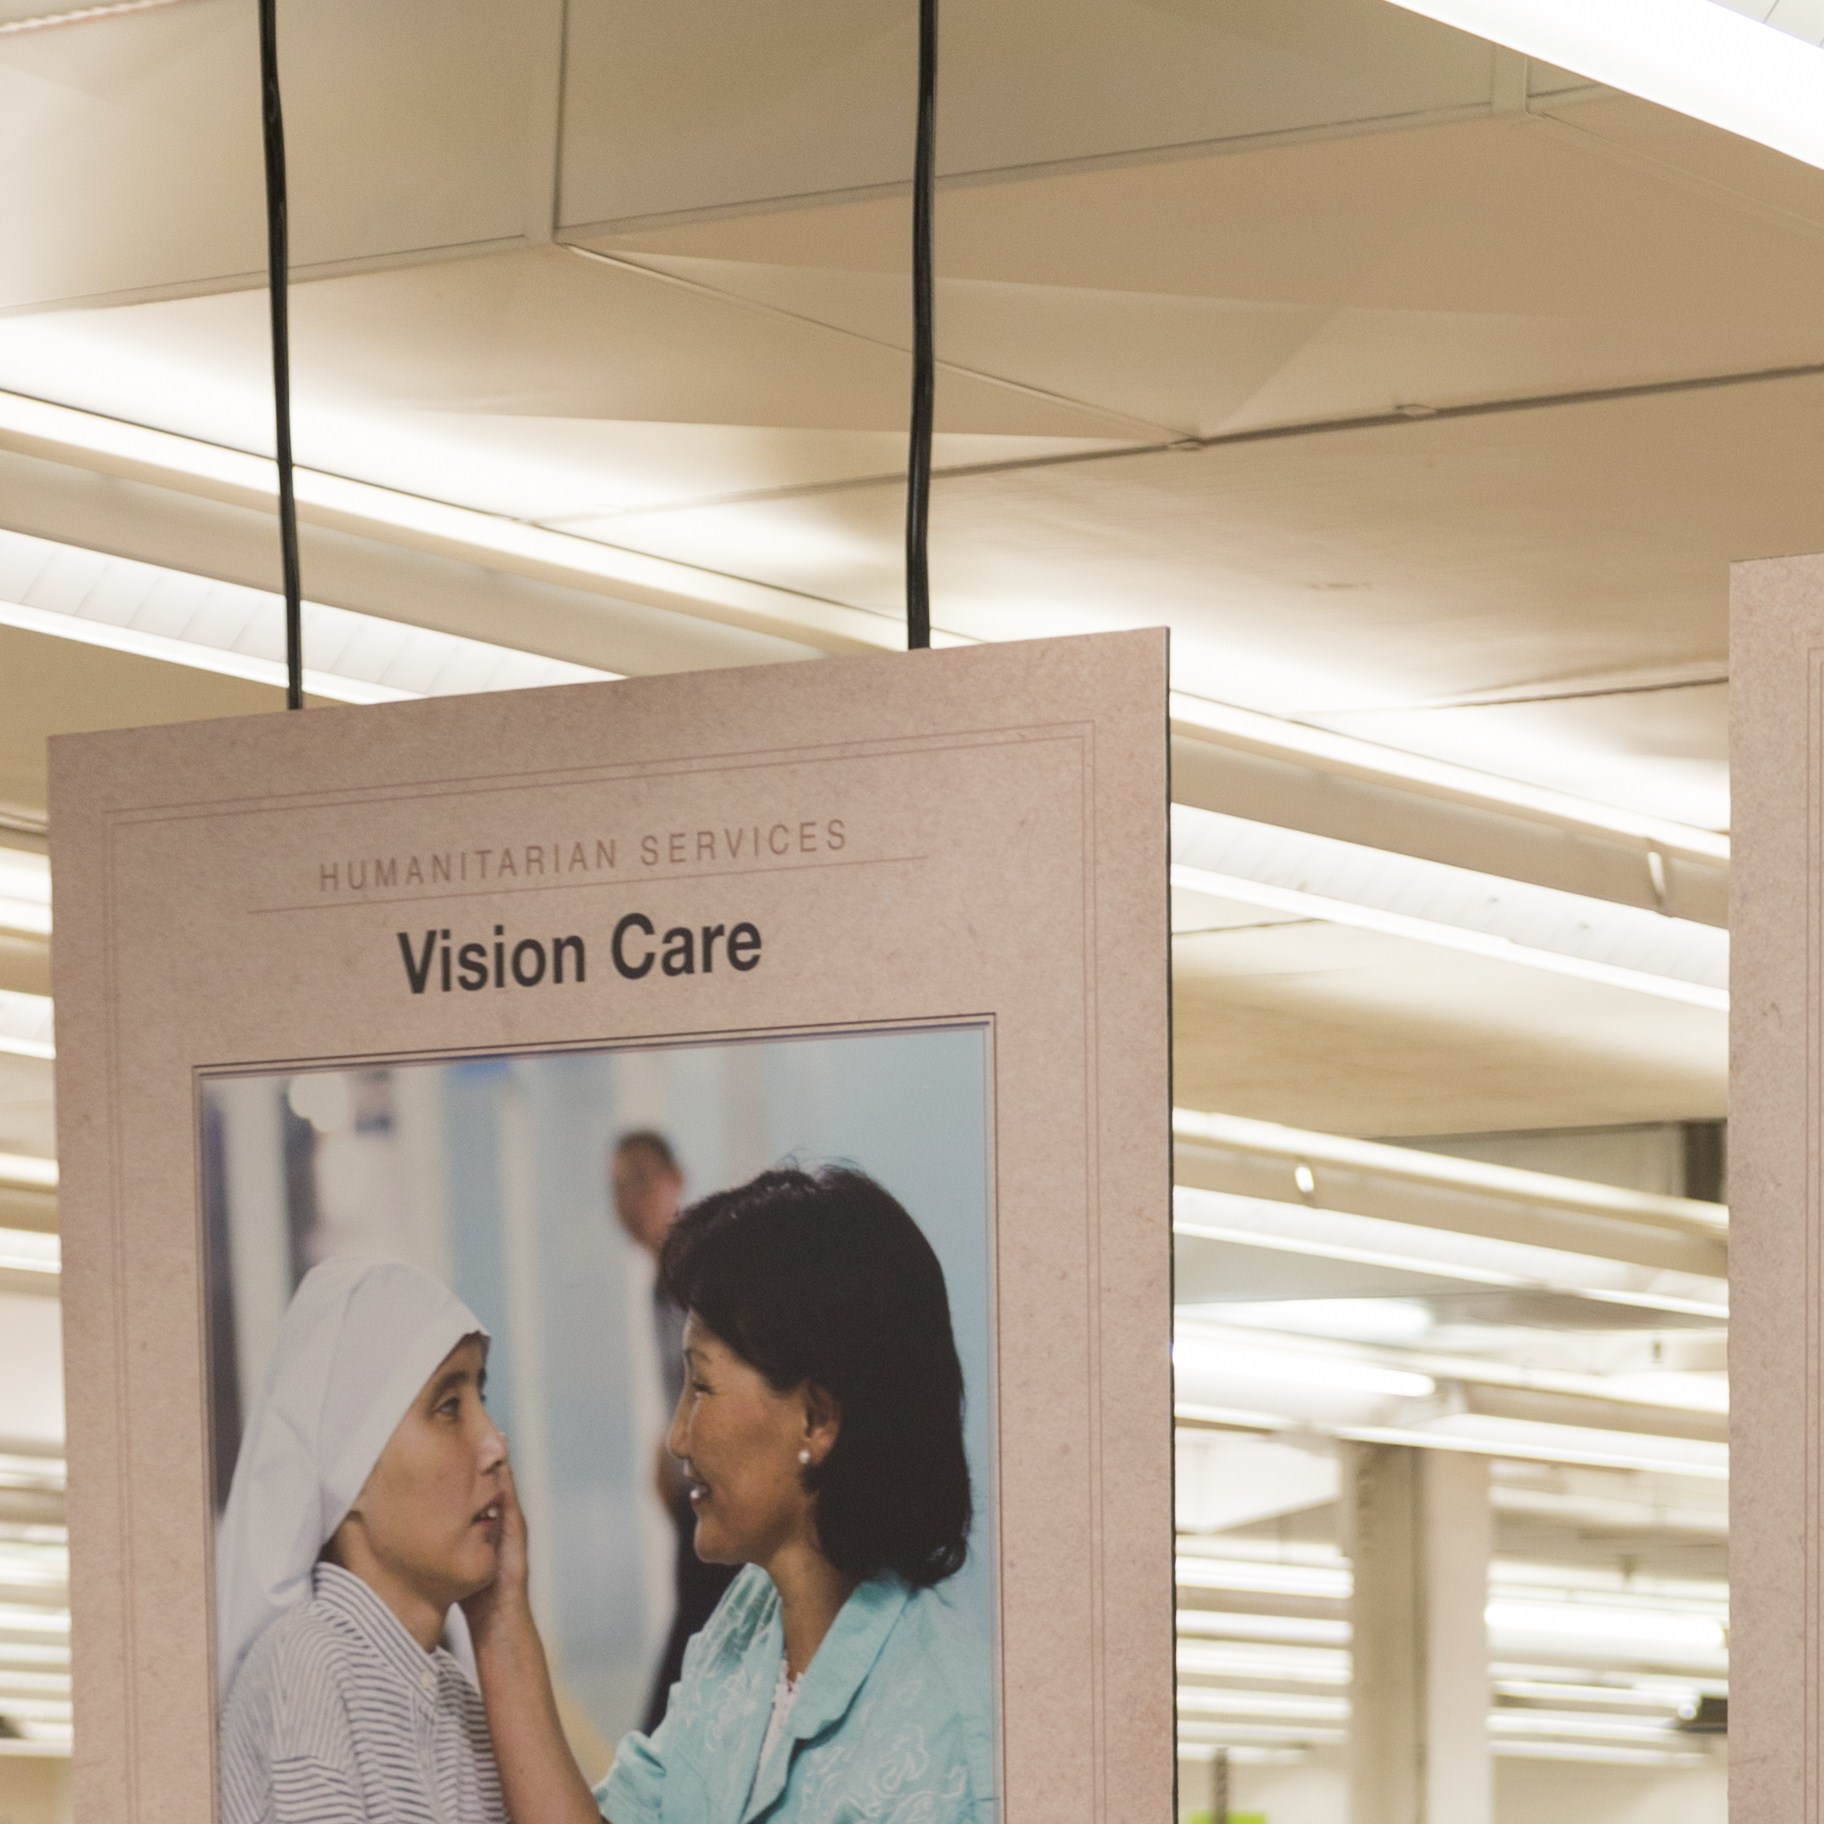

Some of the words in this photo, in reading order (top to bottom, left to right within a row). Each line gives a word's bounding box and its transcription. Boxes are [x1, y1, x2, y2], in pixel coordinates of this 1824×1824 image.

[319, 838, 617, 893] HUMANITARIAN
[640, 818, 847, 867] SERVICES
[396, 925, 586, 995] Vision
[611, 912, 762, 980] Care
